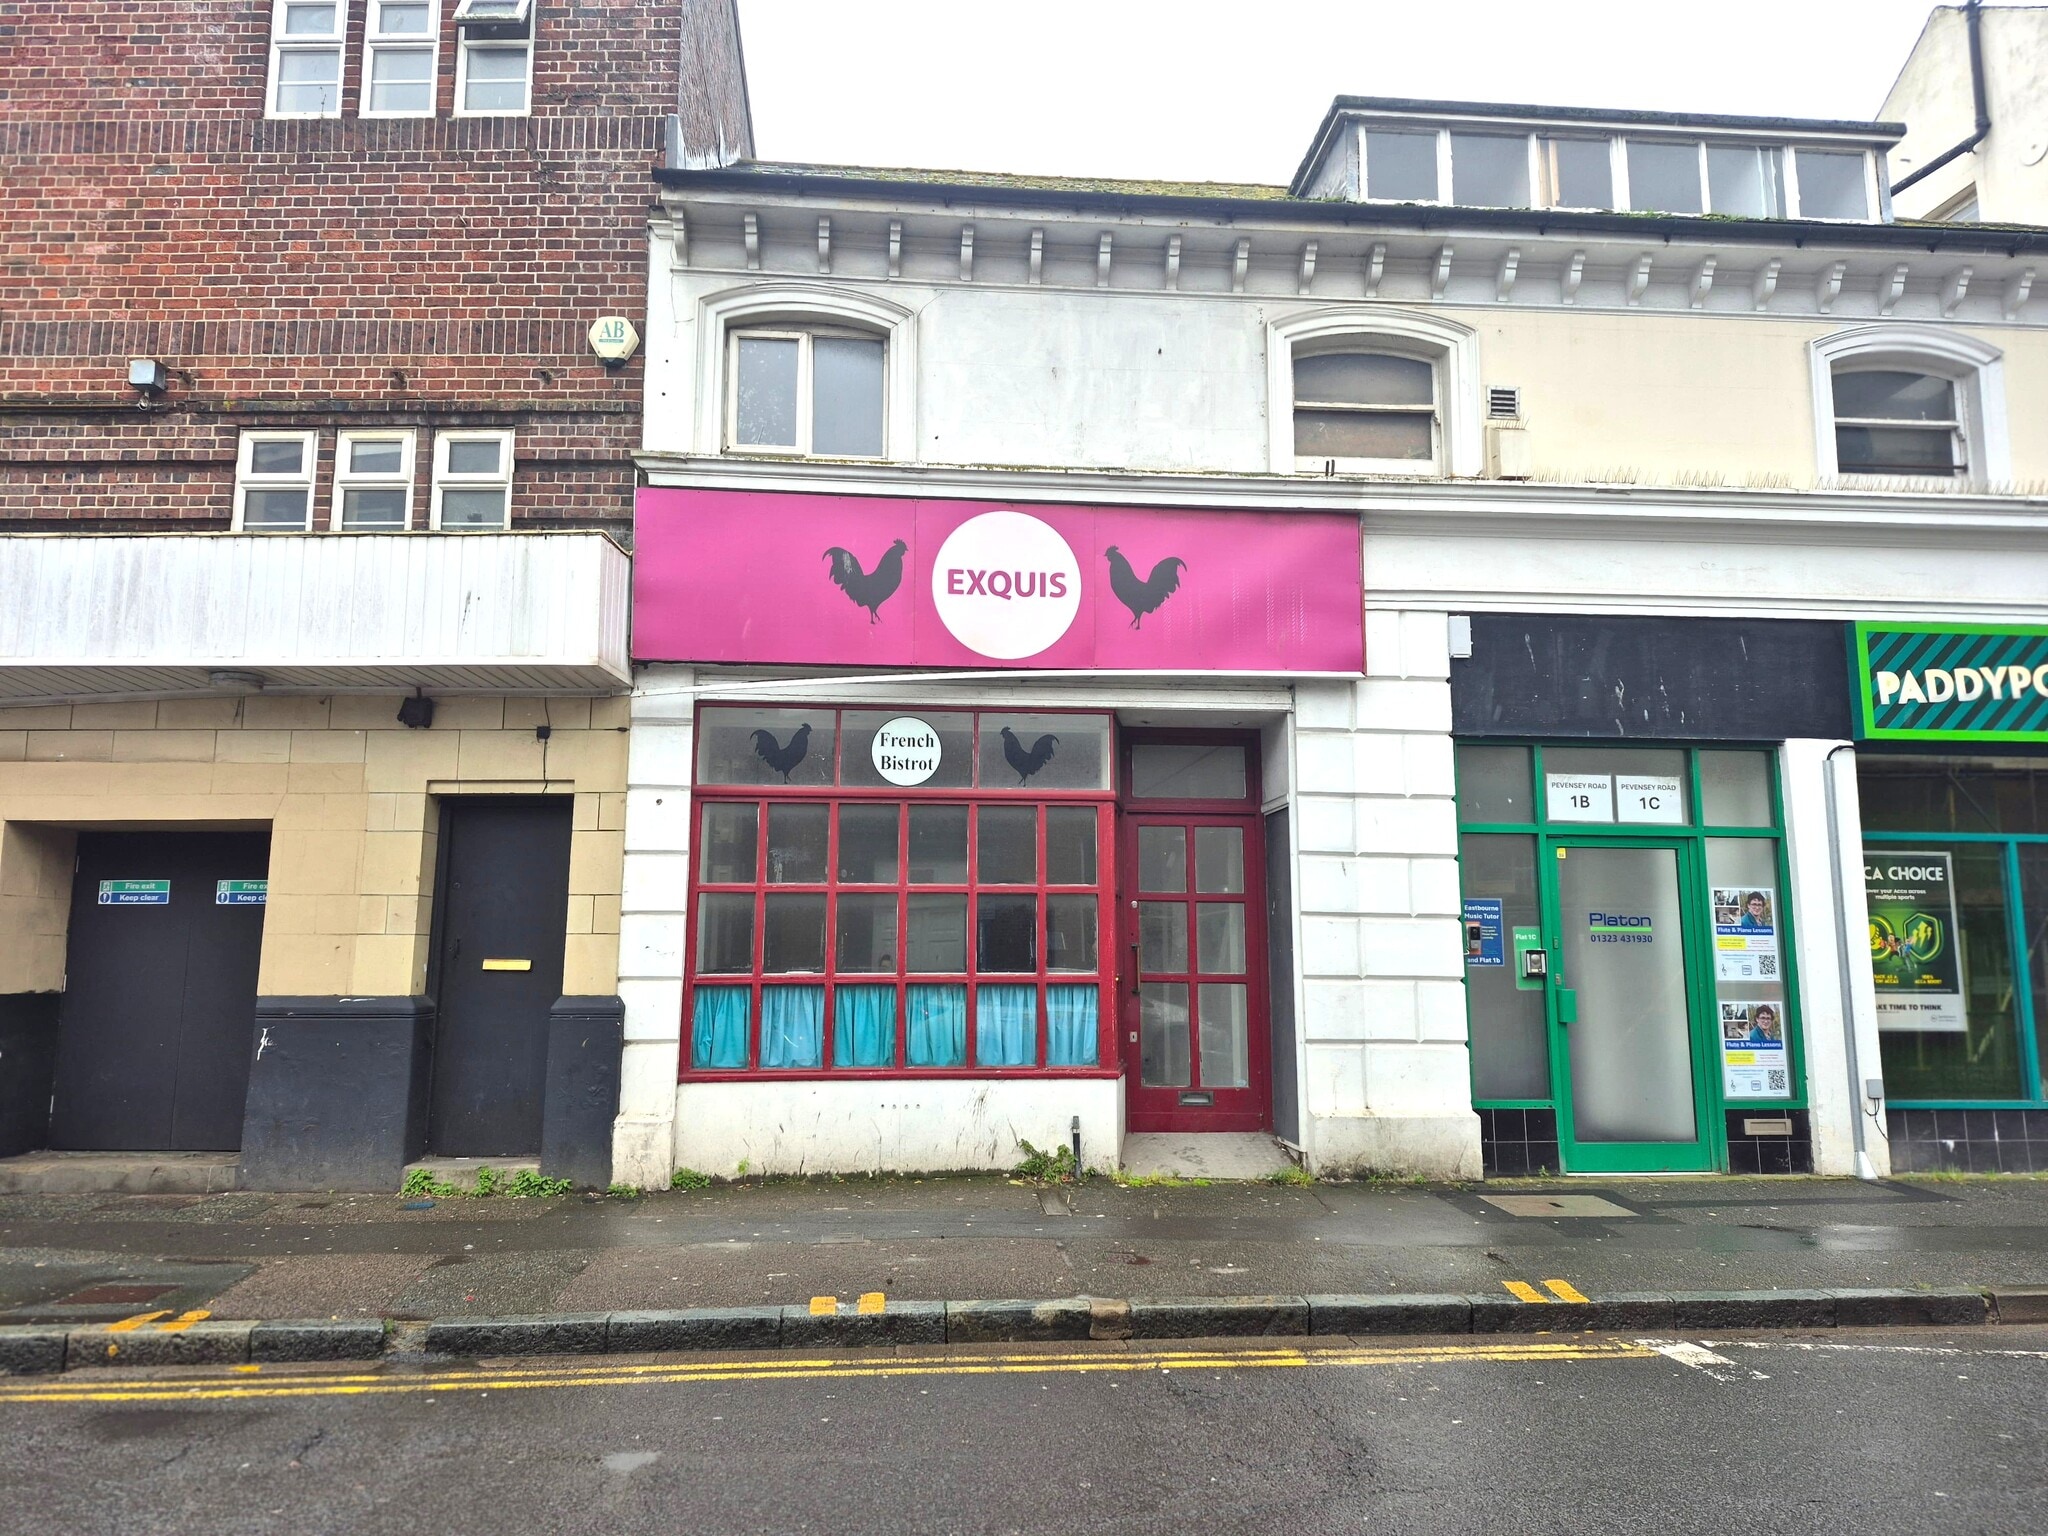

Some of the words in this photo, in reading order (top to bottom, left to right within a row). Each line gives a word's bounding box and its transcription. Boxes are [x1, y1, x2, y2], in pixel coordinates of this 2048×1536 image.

[600, 321, 624, 338] AB
[947, 569, 1067, 600] EXQUIS
[880, 732, 934, 748] French
[881, 755, 933, 771] Bistrot
[1570, 795, 1590, 808] 1B
[1639, 797, 1660, 809] 1C
[1888, 866, 1944, 881] CHOICE
[237, 894, 258, 902] Keep
[1589, 913, 1652, 926] Platon
[1591, 935, 1618, 943] 01323
[1620, 935, 1653, 943] 431930
